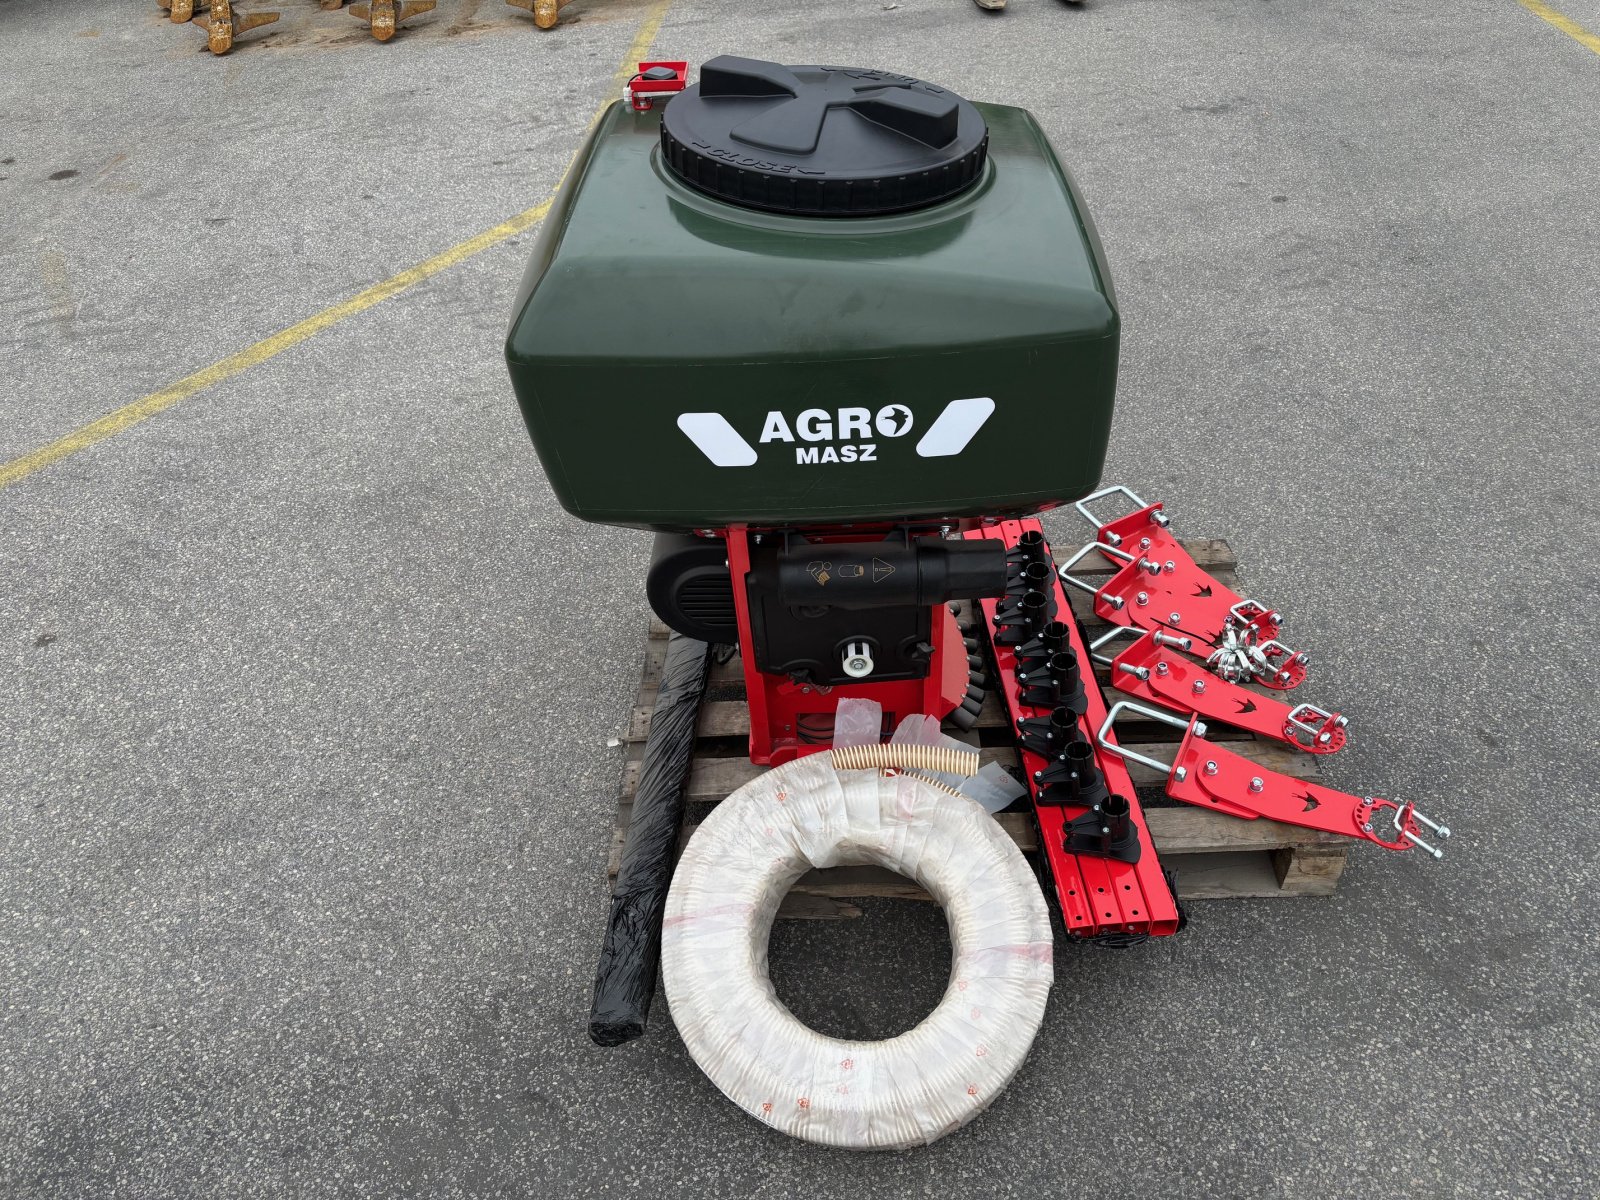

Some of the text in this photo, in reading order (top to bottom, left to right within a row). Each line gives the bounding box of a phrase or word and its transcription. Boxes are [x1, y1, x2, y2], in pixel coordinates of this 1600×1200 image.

[707, 149, 797, 174] CLOSE
[759, 404, 914, 443] AGRO
[796, 444, 878, 465] MASZ
